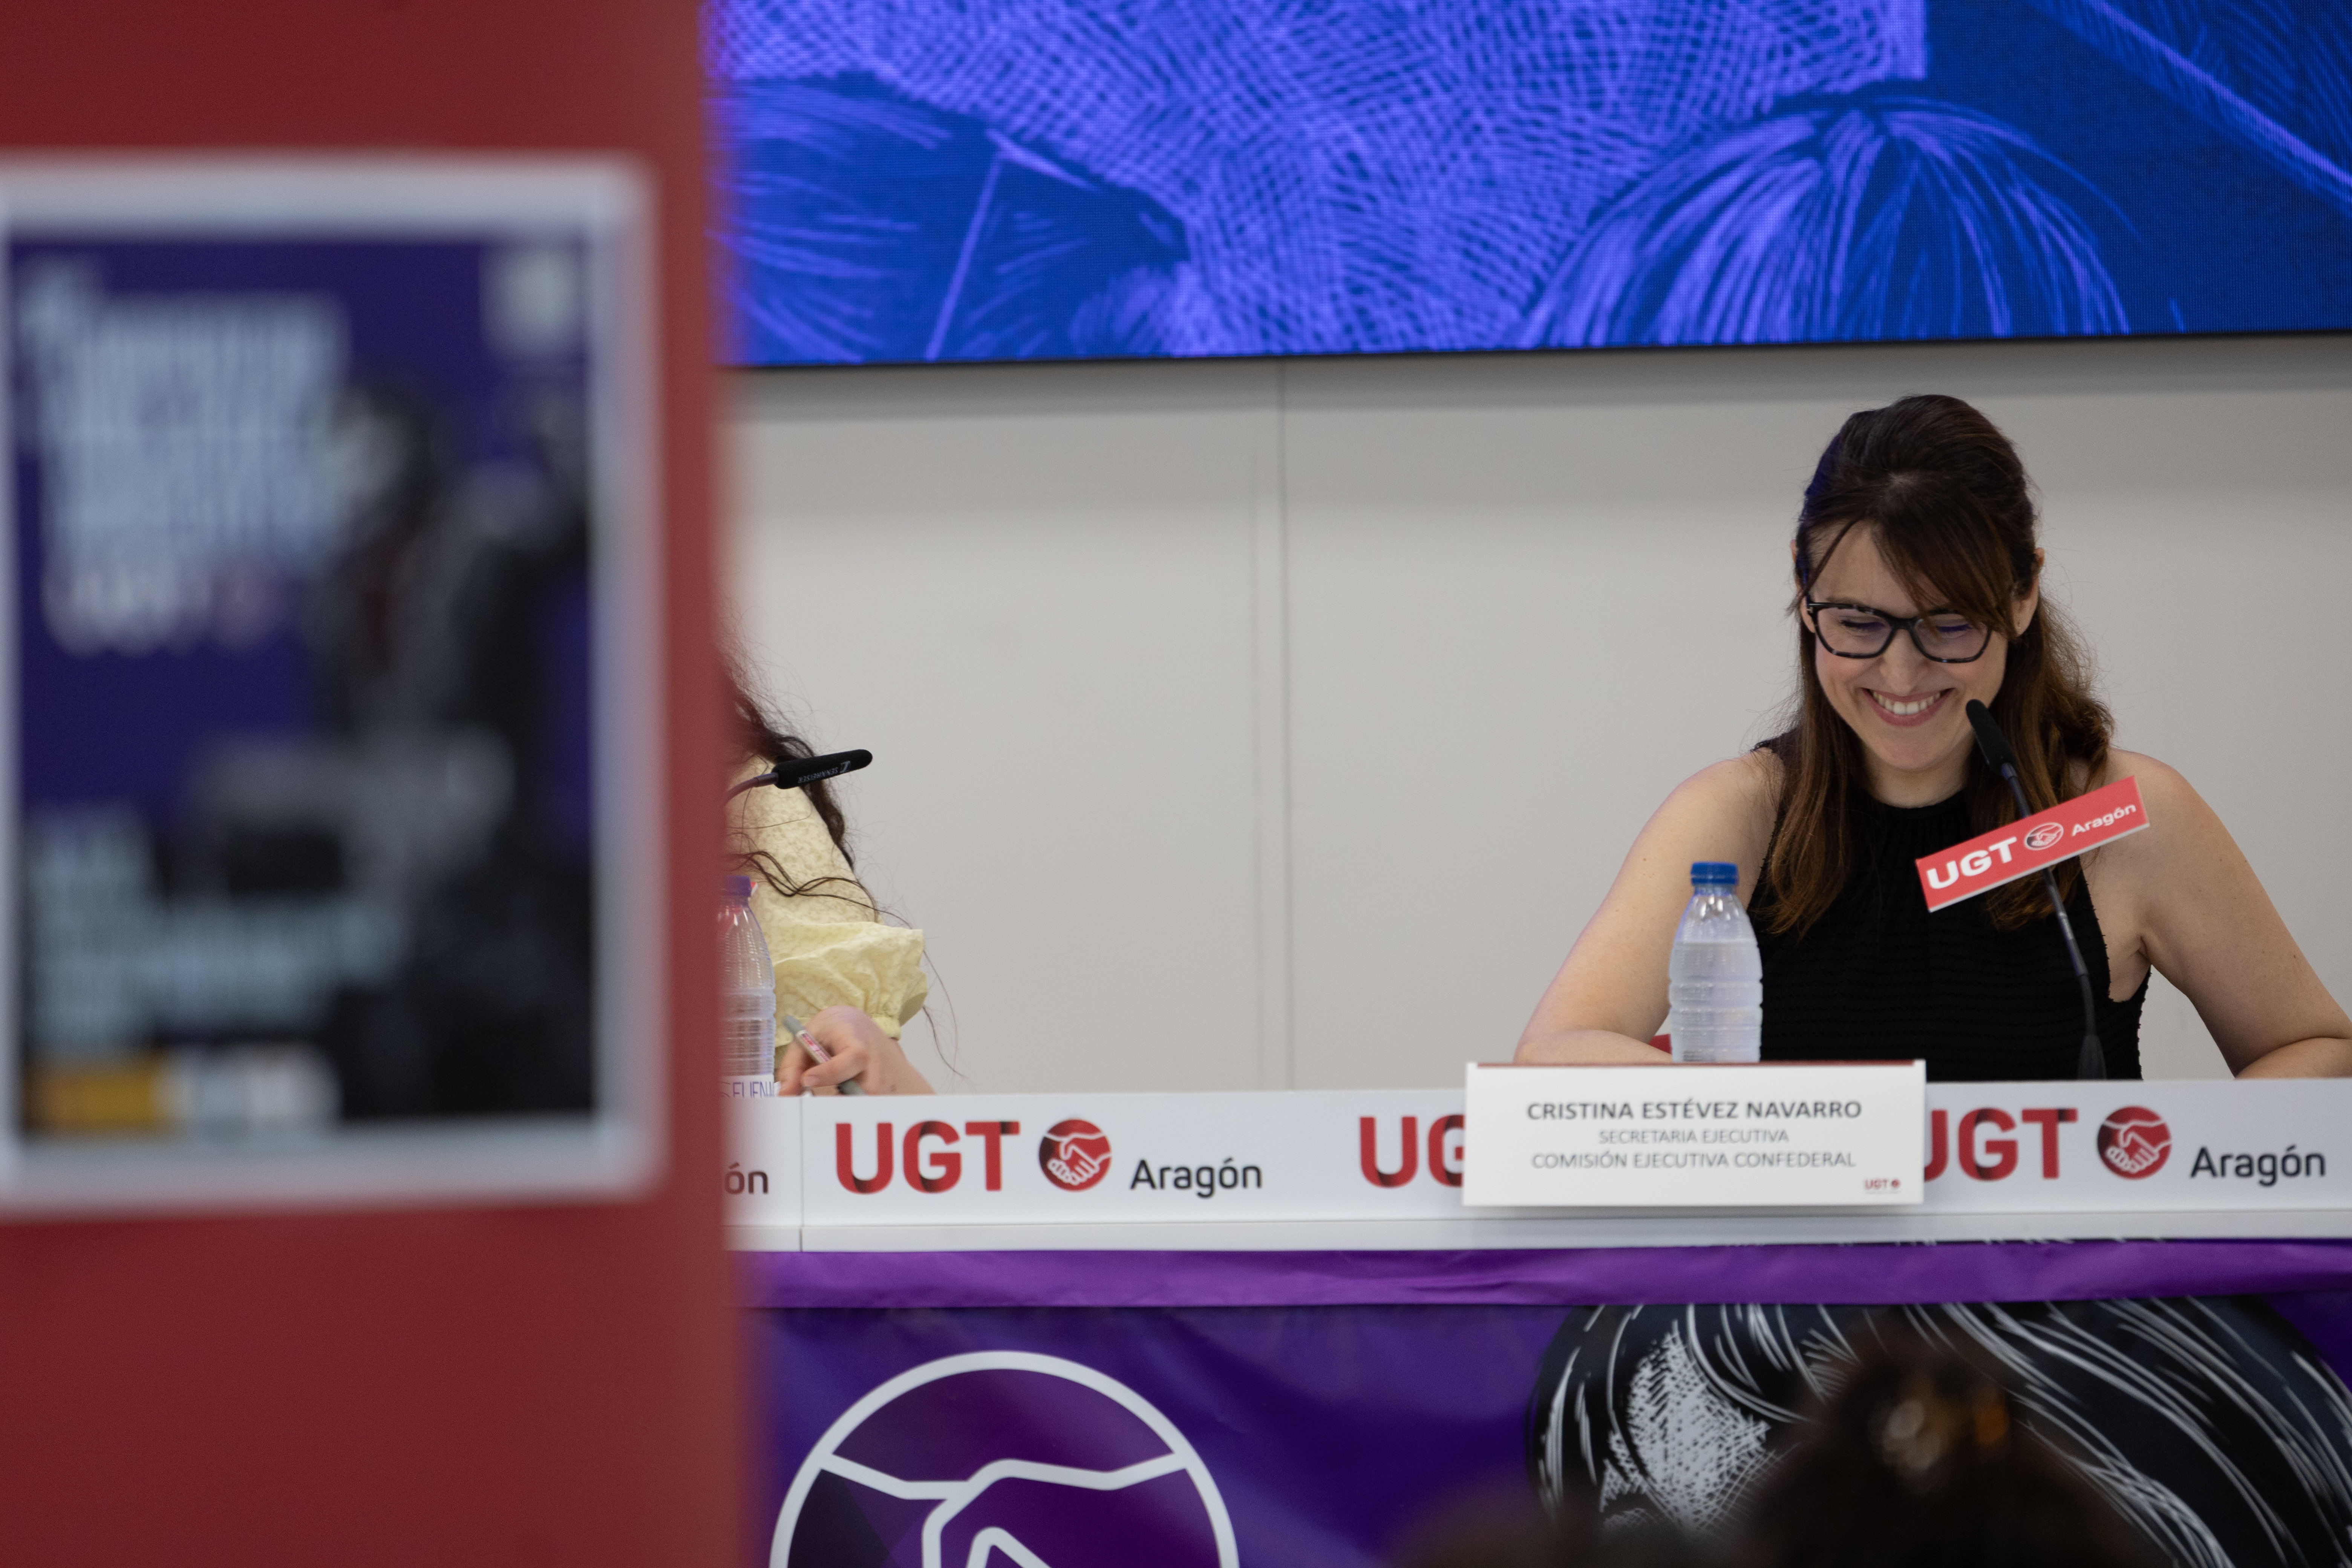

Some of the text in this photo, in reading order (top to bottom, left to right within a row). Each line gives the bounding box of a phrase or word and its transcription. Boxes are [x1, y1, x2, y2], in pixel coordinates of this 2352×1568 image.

[1926, 803, 2137, 890] UGT Aragón
[1527, 1098, 1863, 1121] CRISTINA ESTÉVEZ NAVARRO
[1360, 1114, 1464, 1188] UG
[1599, 1129, 1790, 1145] SECRETARIA EJECUTIVA
[835, 1120, 1020, 1195] UGT
[1130, 1157, 1262, 1199] Aragón
[1531, 1150, 1856, 1170] COMISIÓN EJECUTIVA CONFEDERAL
[2190, 1145, 2326, 1188] Aragón
